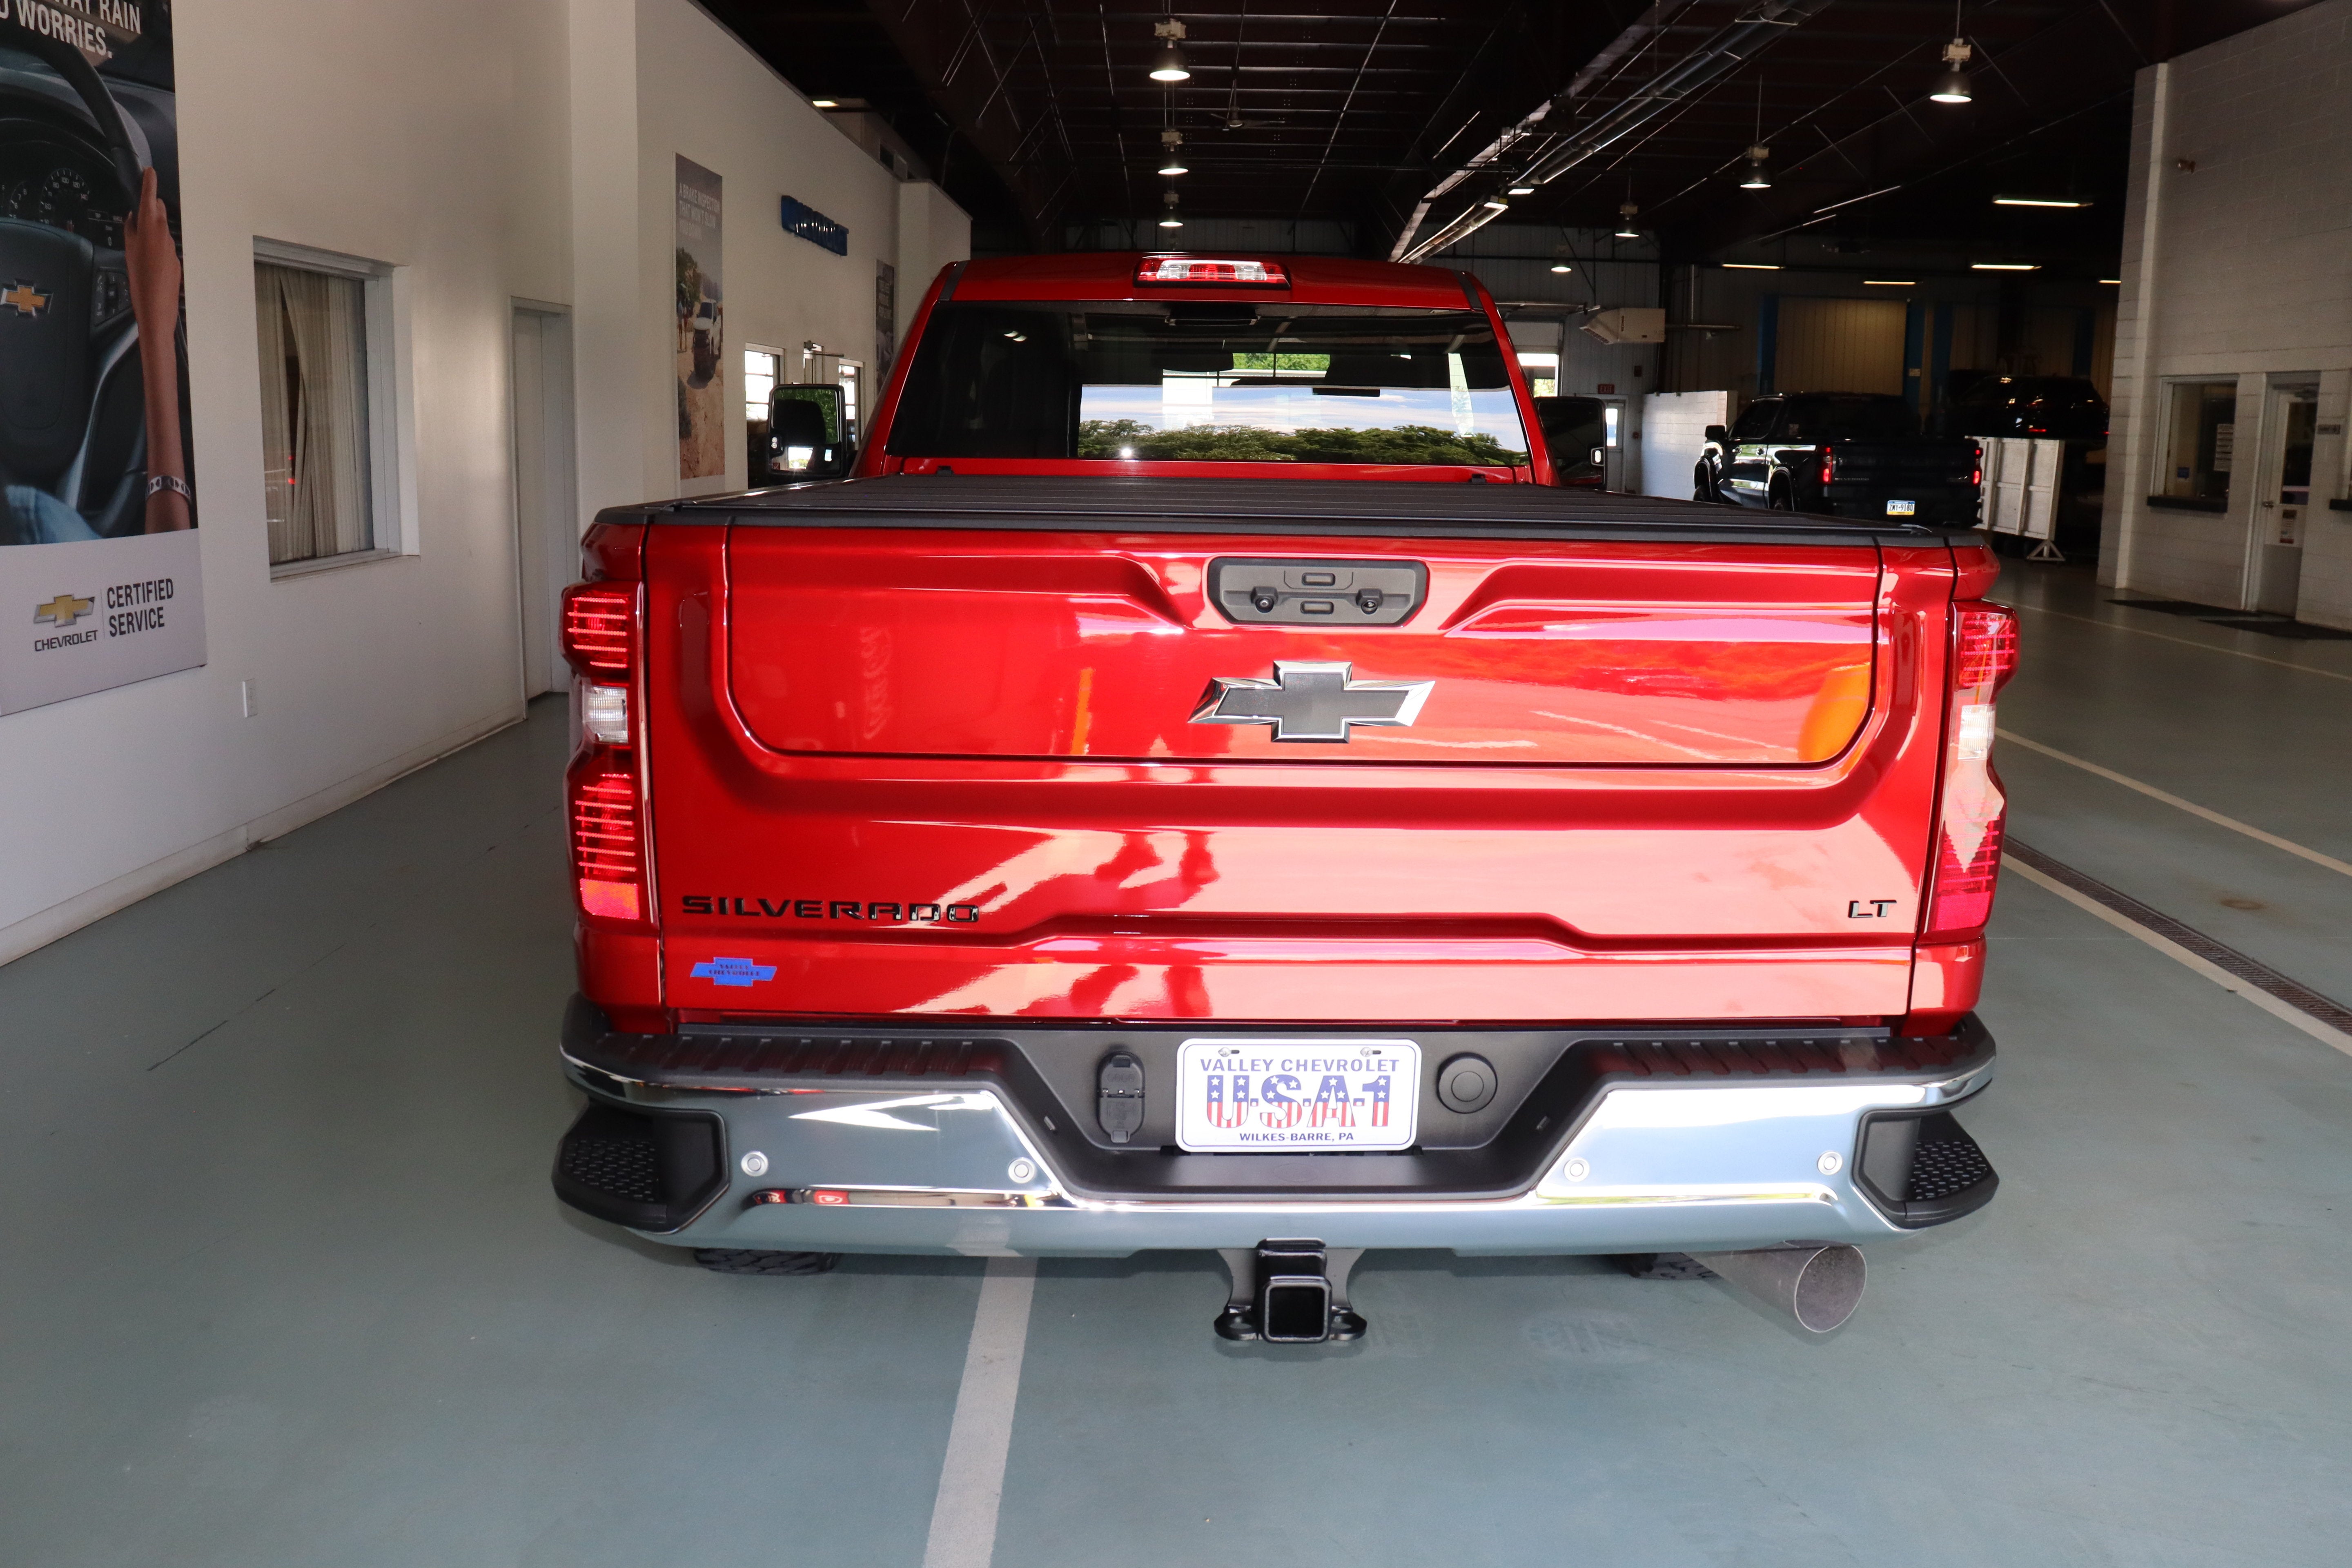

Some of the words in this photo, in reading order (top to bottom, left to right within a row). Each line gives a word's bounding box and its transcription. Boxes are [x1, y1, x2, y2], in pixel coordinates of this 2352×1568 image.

[16, 0, 112, 58] WORRIES.
[99, 0, 141, 34] RAIN
[107, 578, 174, 609] CERTIFIED
[109, 607, 165, 637] SERVICE
[35, 630, 98, 651] CHEVROLET
[682, 896, 979, 922] SILVERADO
[1848, 900, 1897, 918] LT
[1200, 1059, 1274, 1072] VALLEY
[1281, 1059, 1399, 1072] CHEVROLET
[1240, 1133, 1334, 1142] WILKES-BARRE,
[1339, 1132, 1354, 1141] PA
